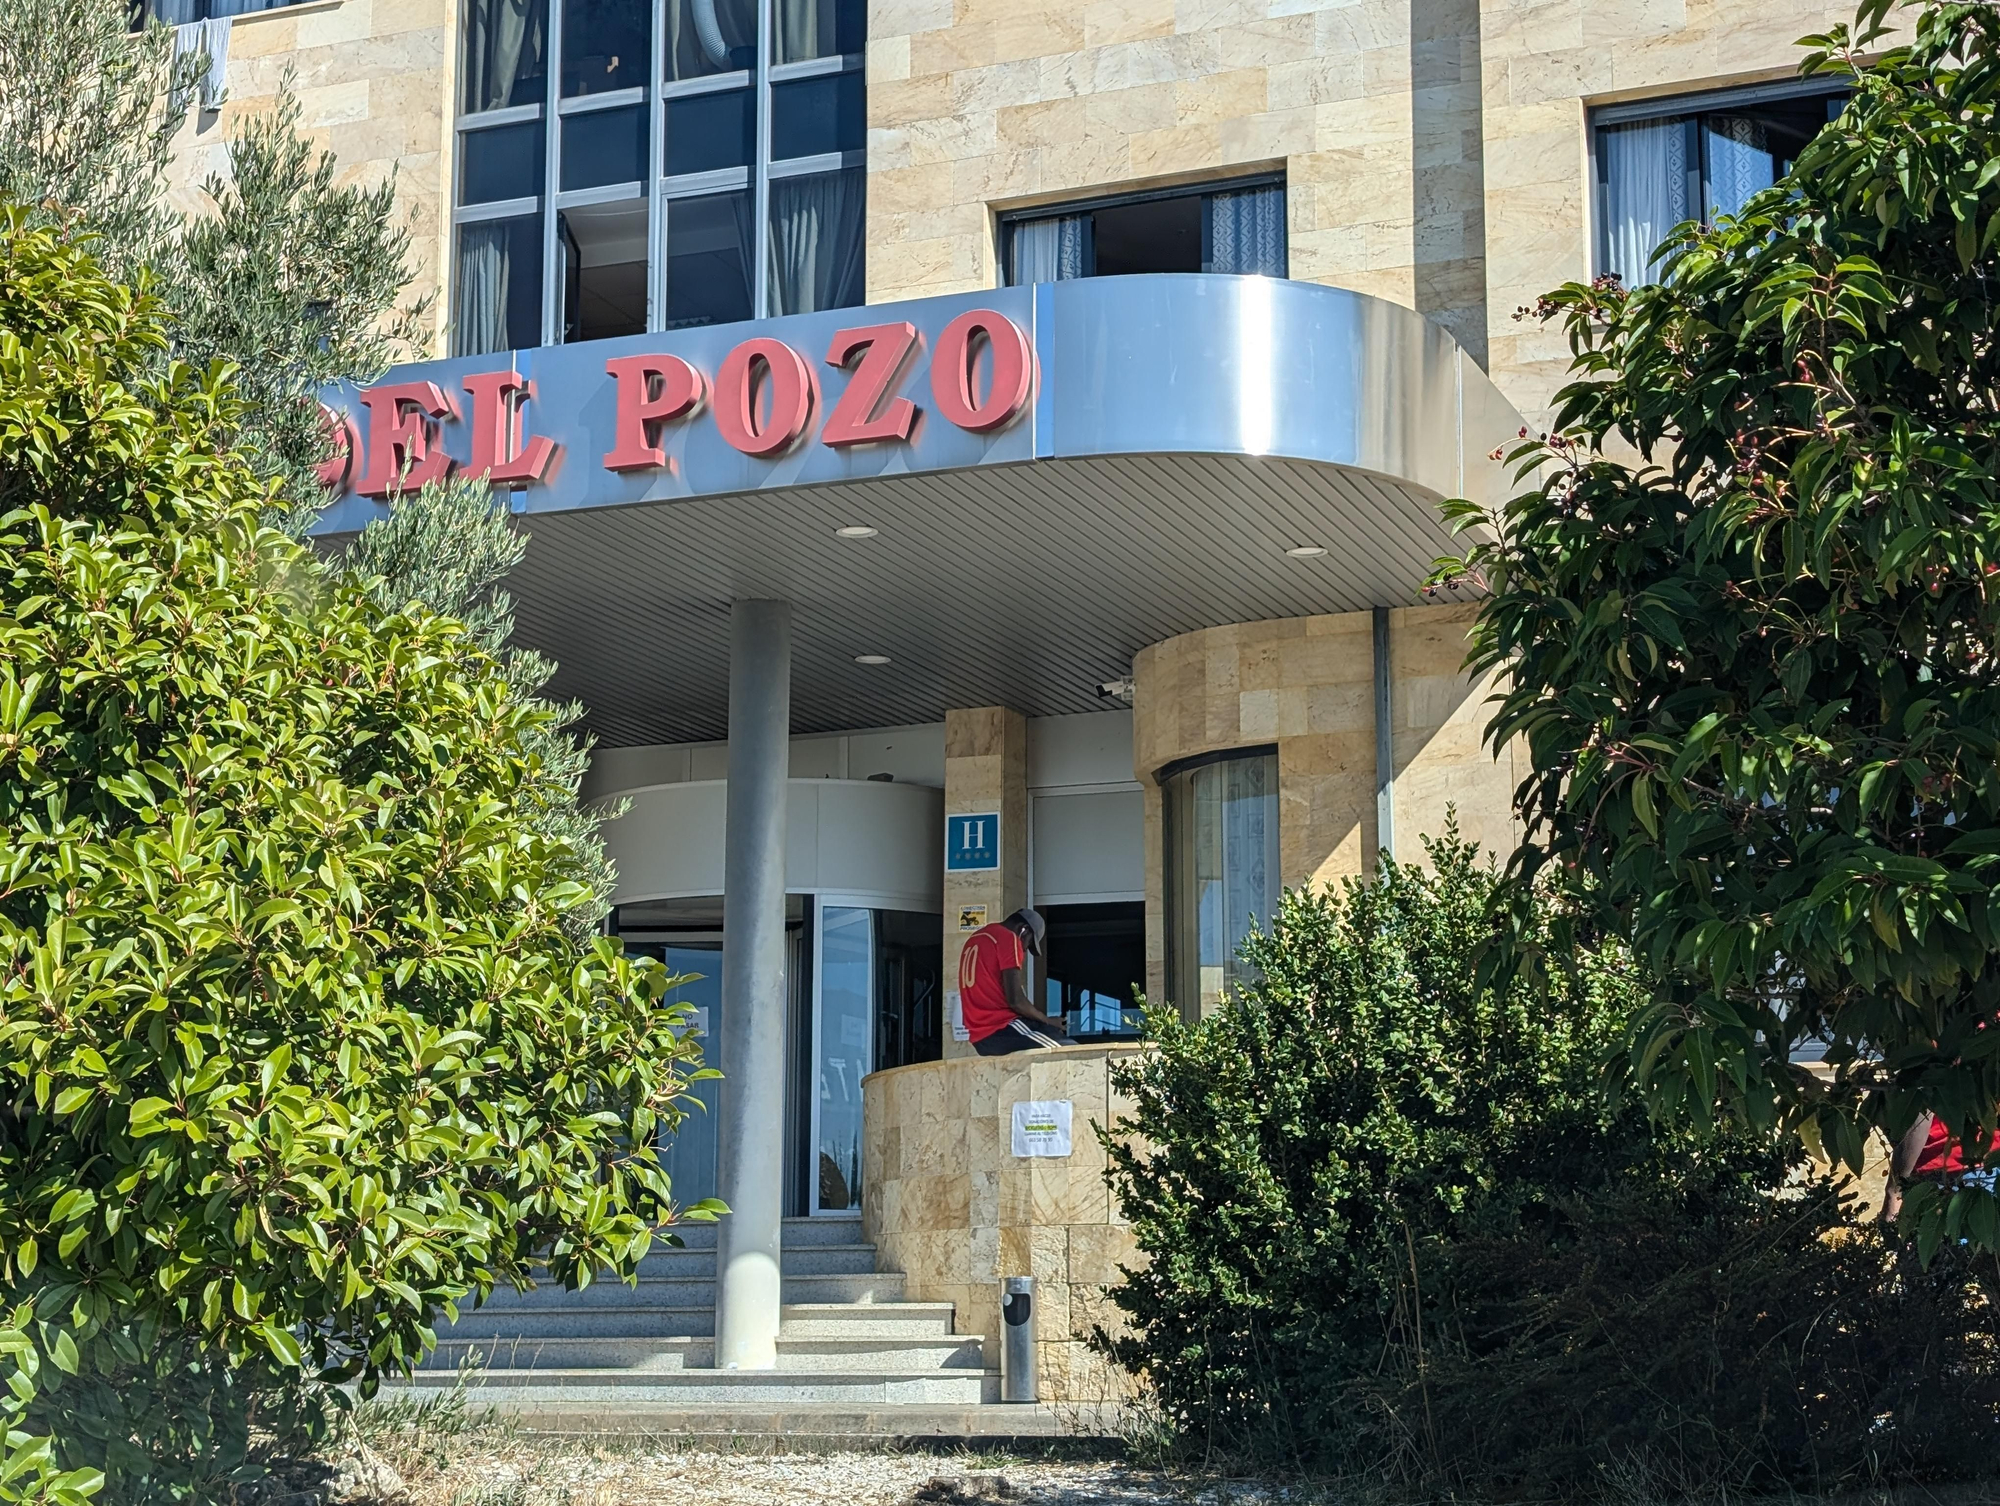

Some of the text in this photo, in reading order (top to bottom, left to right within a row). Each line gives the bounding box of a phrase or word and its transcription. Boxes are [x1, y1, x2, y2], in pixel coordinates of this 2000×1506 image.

[604, 308, 1031, 472] POZO
[962, 820, 986, 849] H
[961, 944, 978, 989] 10
